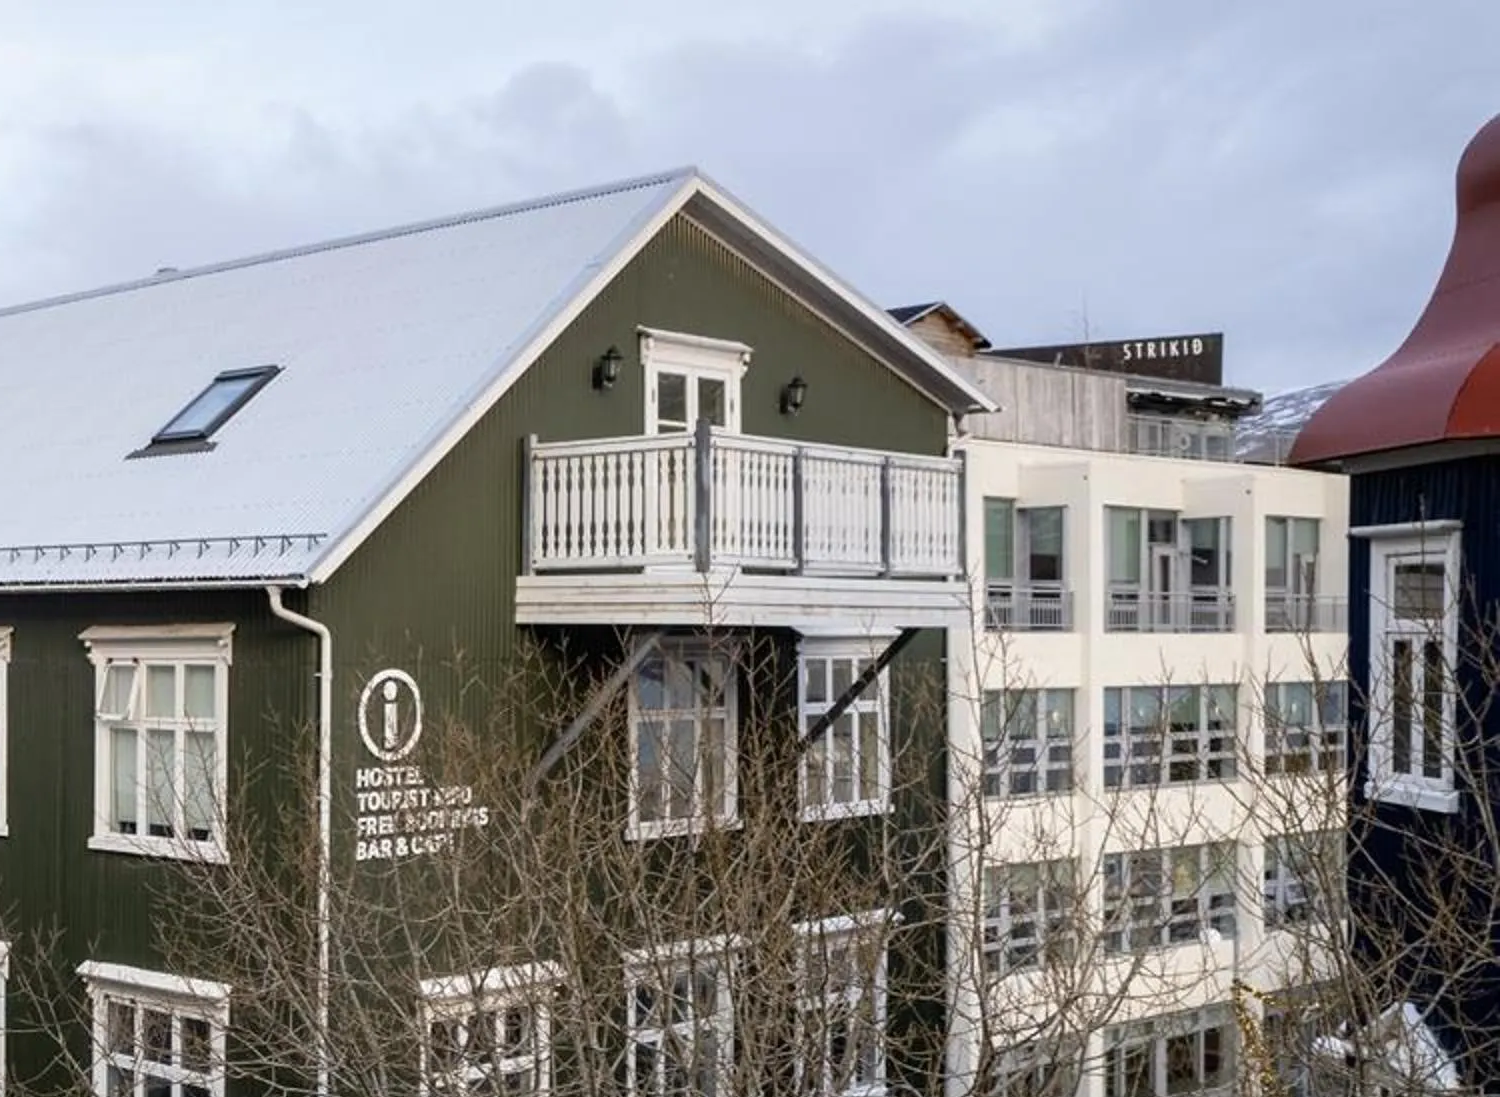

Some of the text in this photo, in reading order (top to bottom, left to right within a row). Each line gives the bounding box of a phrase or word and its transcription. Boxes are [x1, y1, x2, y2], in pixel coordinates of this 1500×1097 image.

[356, 766, 425, 788] HOSTEL
[356, 787, 431, 812] TOURIST
[356, 839, 393, 861] BAR
[396, 836, 409, 857] &
